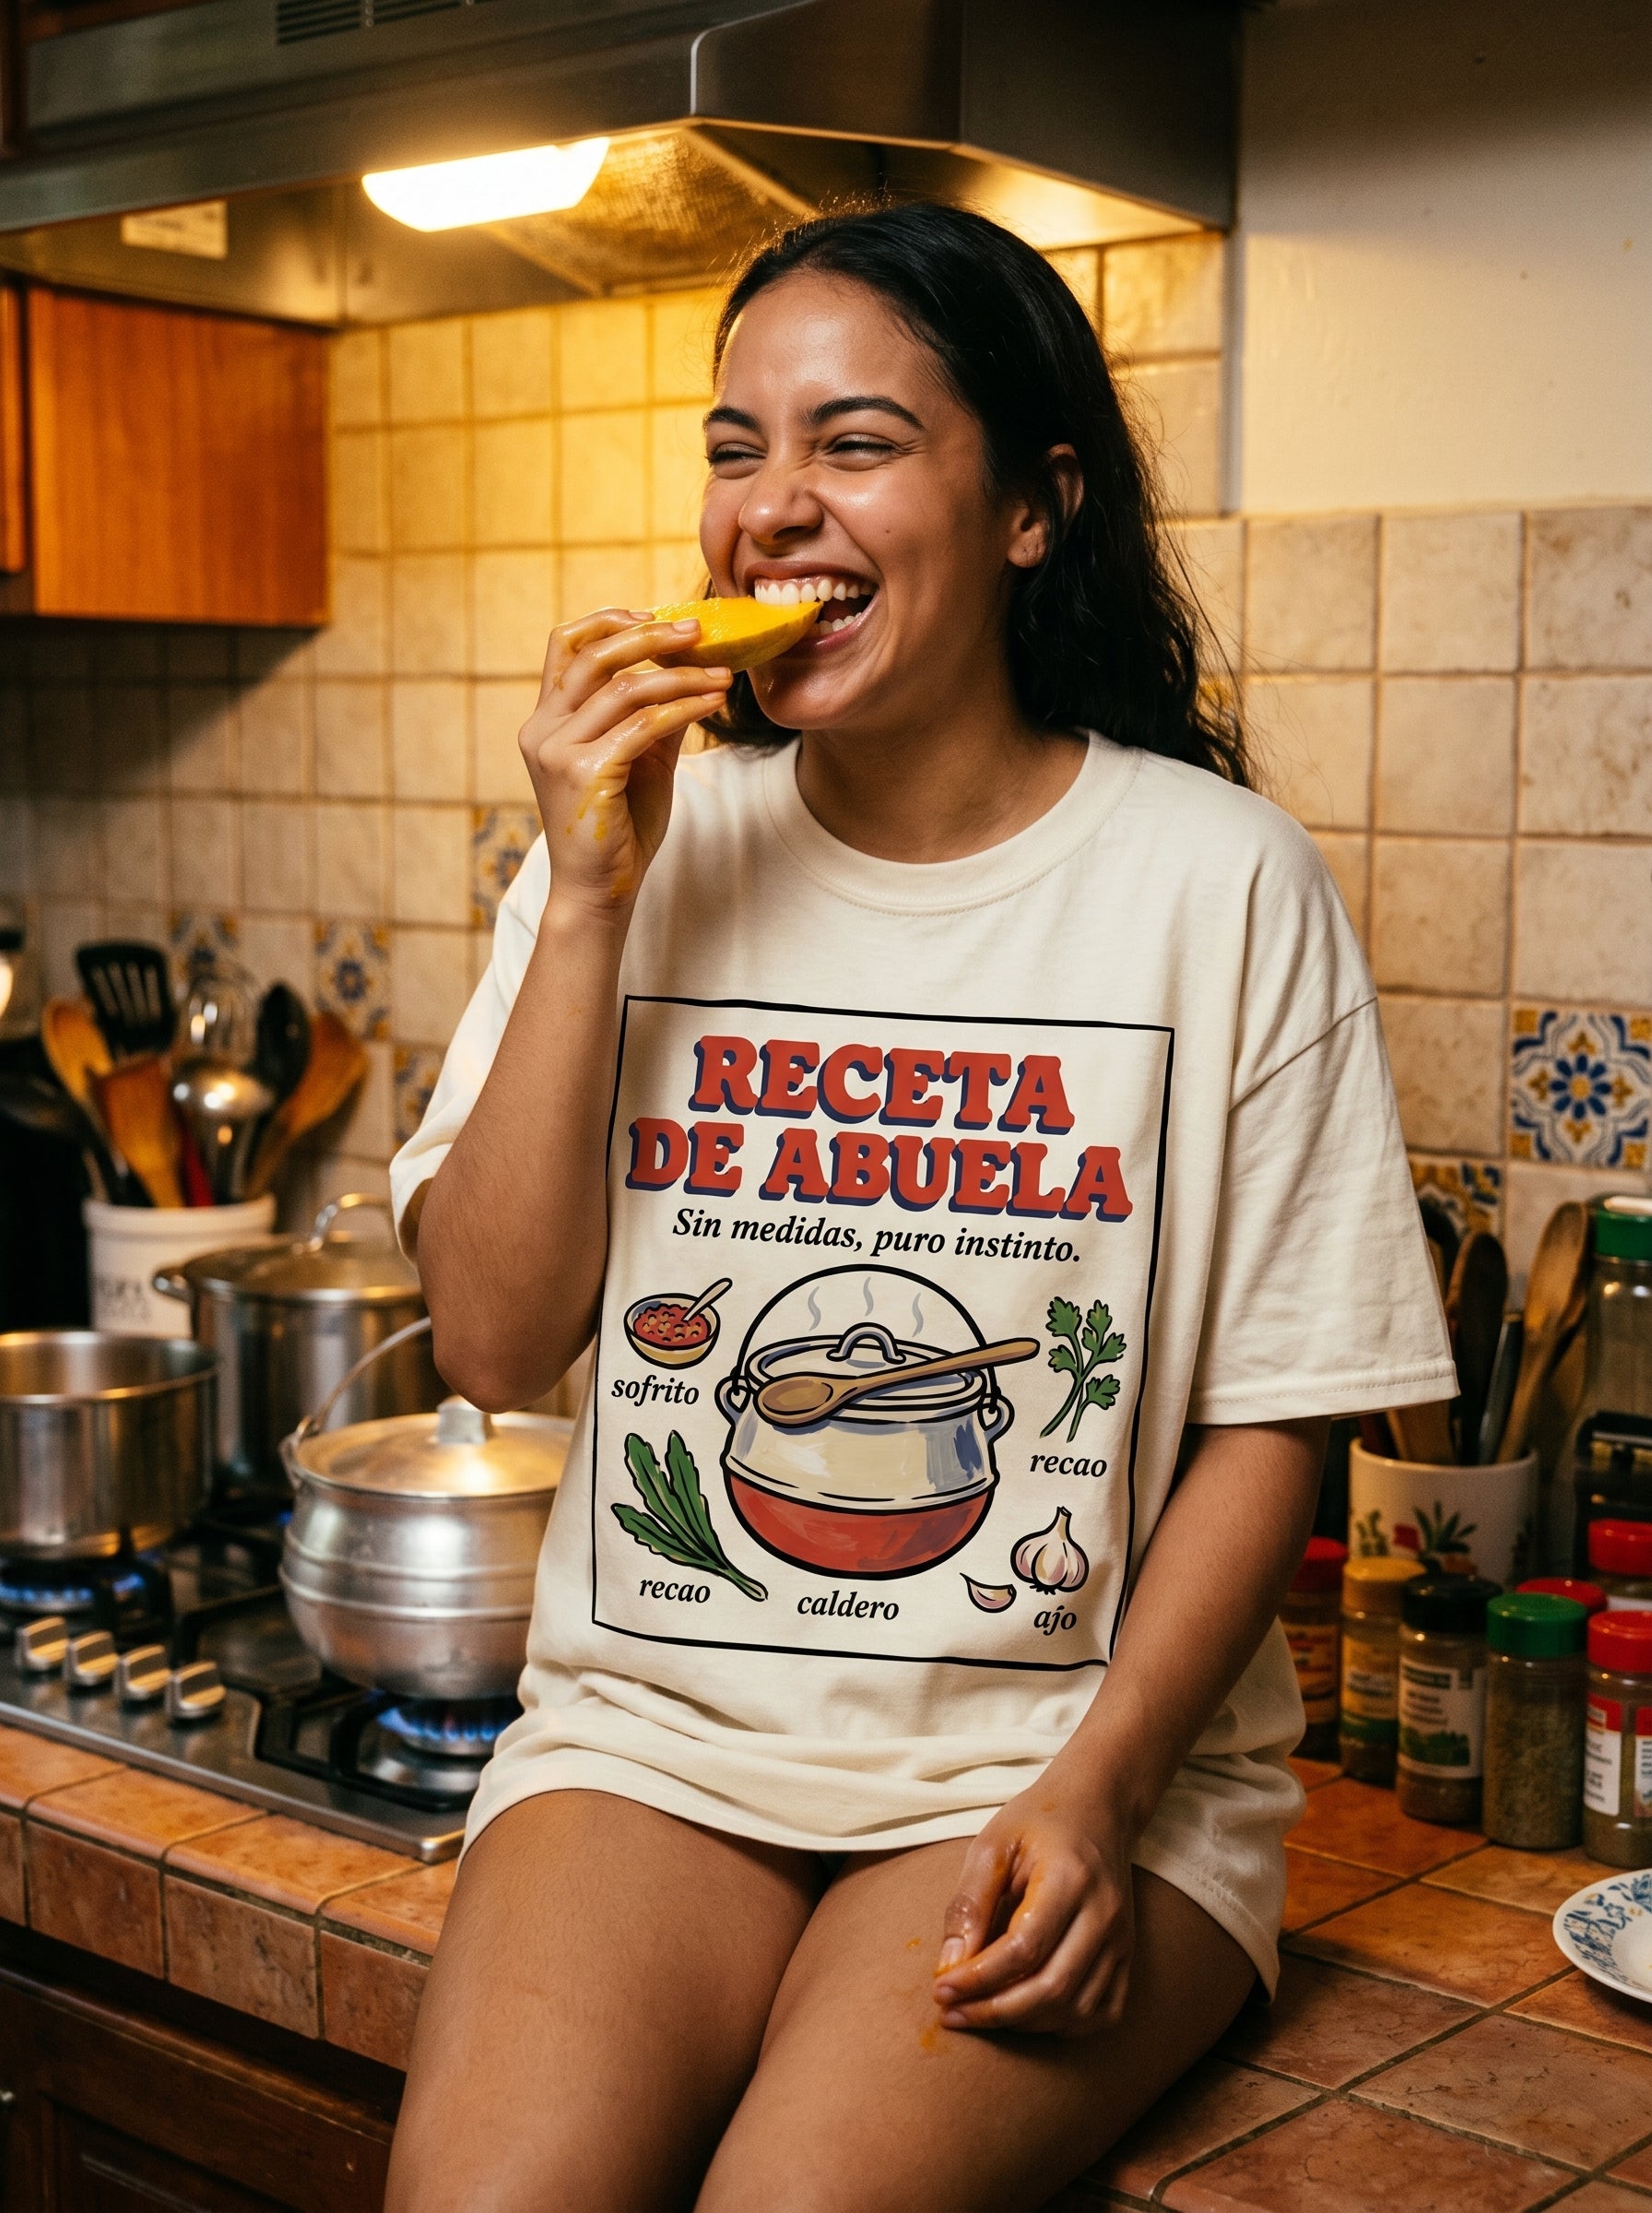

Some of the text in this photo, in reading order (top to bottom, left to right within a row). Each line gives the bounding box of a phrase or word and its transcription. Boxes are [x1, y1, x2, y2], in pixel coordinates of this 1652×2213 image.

[688, 1035, 1075, 1136] RECETA
[625, 1117, 1133, 1223] DE ABUELA
[672, 1208, 1080, 1262] Sin medidas, puro instinto.
[610, 1374, 700, 1407] sofrito
[1030, 1454, 1107, 1478] recao
[639, 1579, 711, 1604] recao
[796, 1590, 900, 1621] caldero
[1033, 1604, 1078, 1637] ajo
